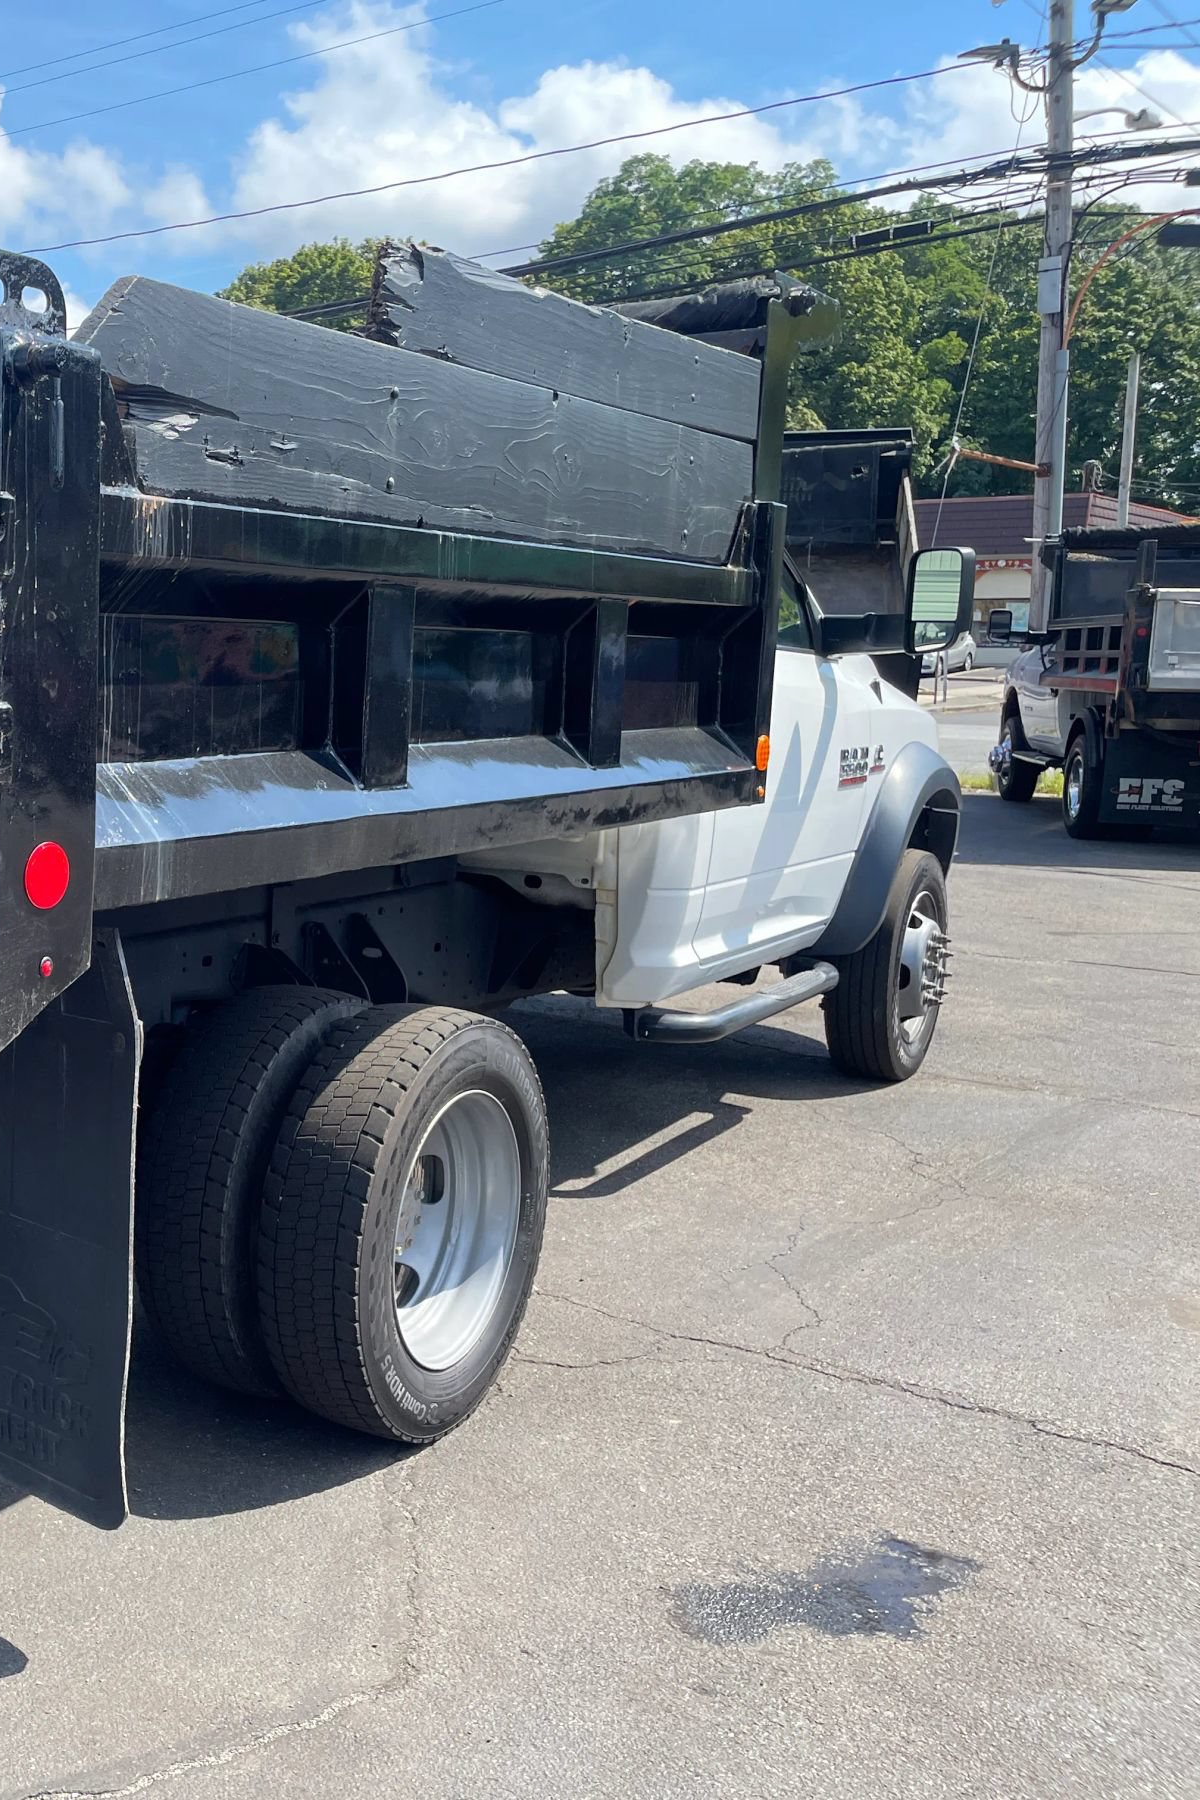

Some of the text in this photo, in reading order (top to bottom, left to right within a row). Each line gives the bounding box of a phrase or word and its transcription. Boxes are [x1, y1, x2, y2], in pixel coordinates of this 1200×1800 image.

[1117, 777, 1185, 805] EFS
[385, 1365, 405, 1402] HDR
[1, 1365, 91, 1440] TRUCK
[400, 1391, 426, 1421] Conti
